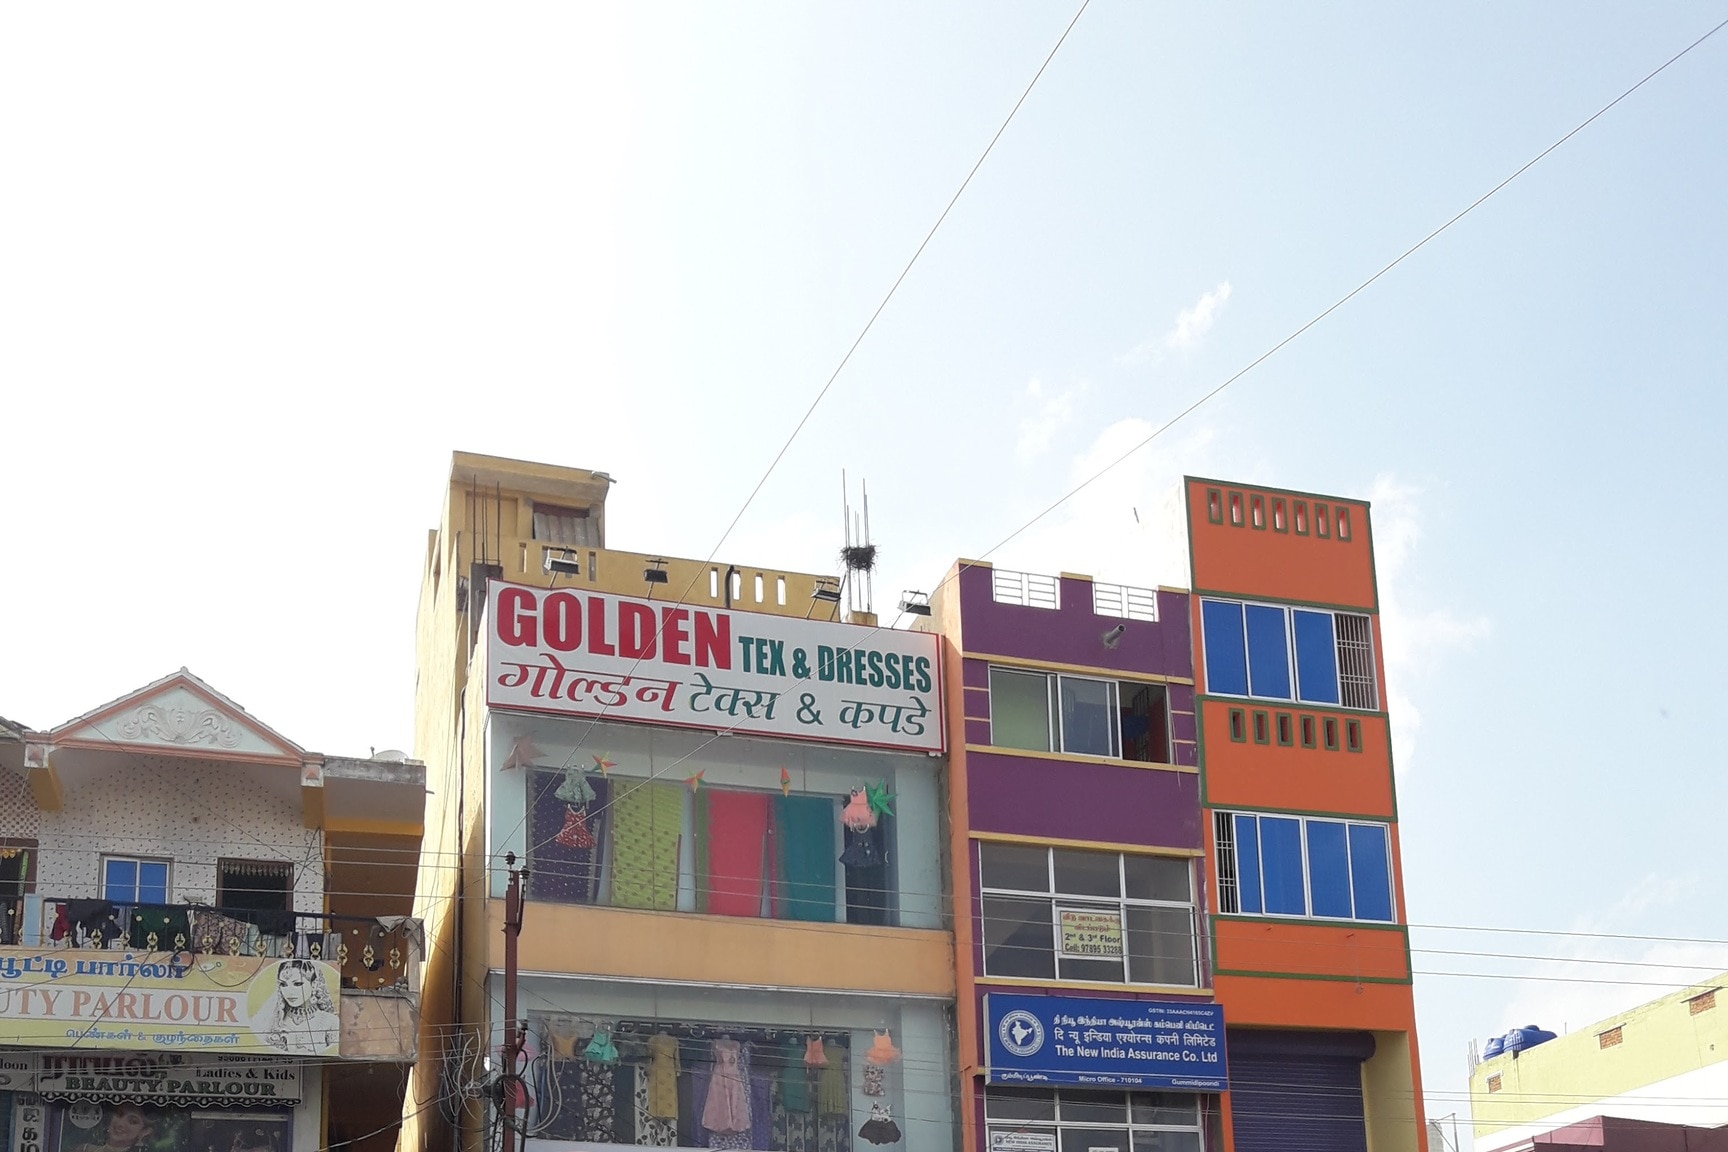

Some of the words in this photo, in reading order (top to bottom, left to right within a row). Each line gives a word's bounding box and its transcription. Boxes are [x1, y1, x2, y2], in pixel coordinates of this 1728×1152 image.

[496, 587, 731, 671] GOLDEN
[738, 635, 785, 677] TEX
[791, 646, 813, 681] &
[818, 644, 931, 694] DRESSES
[497, 652, 684, 713] गोल्डन
[689, 671, 782, 721] टेक्स
[796, 691, 824, 726] &
[1078, 933, 1085, 942] &
[1099, 934, 1121, 944] Floor
[71, 989, 239, 1023] PARLOUR
[137, 1031, 147, 1041] &
[1055, 1045, 1075, 1057] The
[1077, 1046, 1098, 1058] New
[1101, 1047, 1125, 1059] India
[1127, 1049, 1180, 1062] Assurance
[1182, 1052, 1199, 1063] Co.
[1201, 1052, 1218, 1063] Ltd
[246, 1069, 259, 1079] &
[263, 1069, 296, 1081] Kids
[1078, 1075, 1096, 1083] Micro
[1097, 1076, 1116, 1084] Office
[65, 1077, 162, 1093] BEAUTY
[167, 1080, 277, 1097] PARLOUR
[1171, 1079, 1220, 1088] Gummidipoondi
